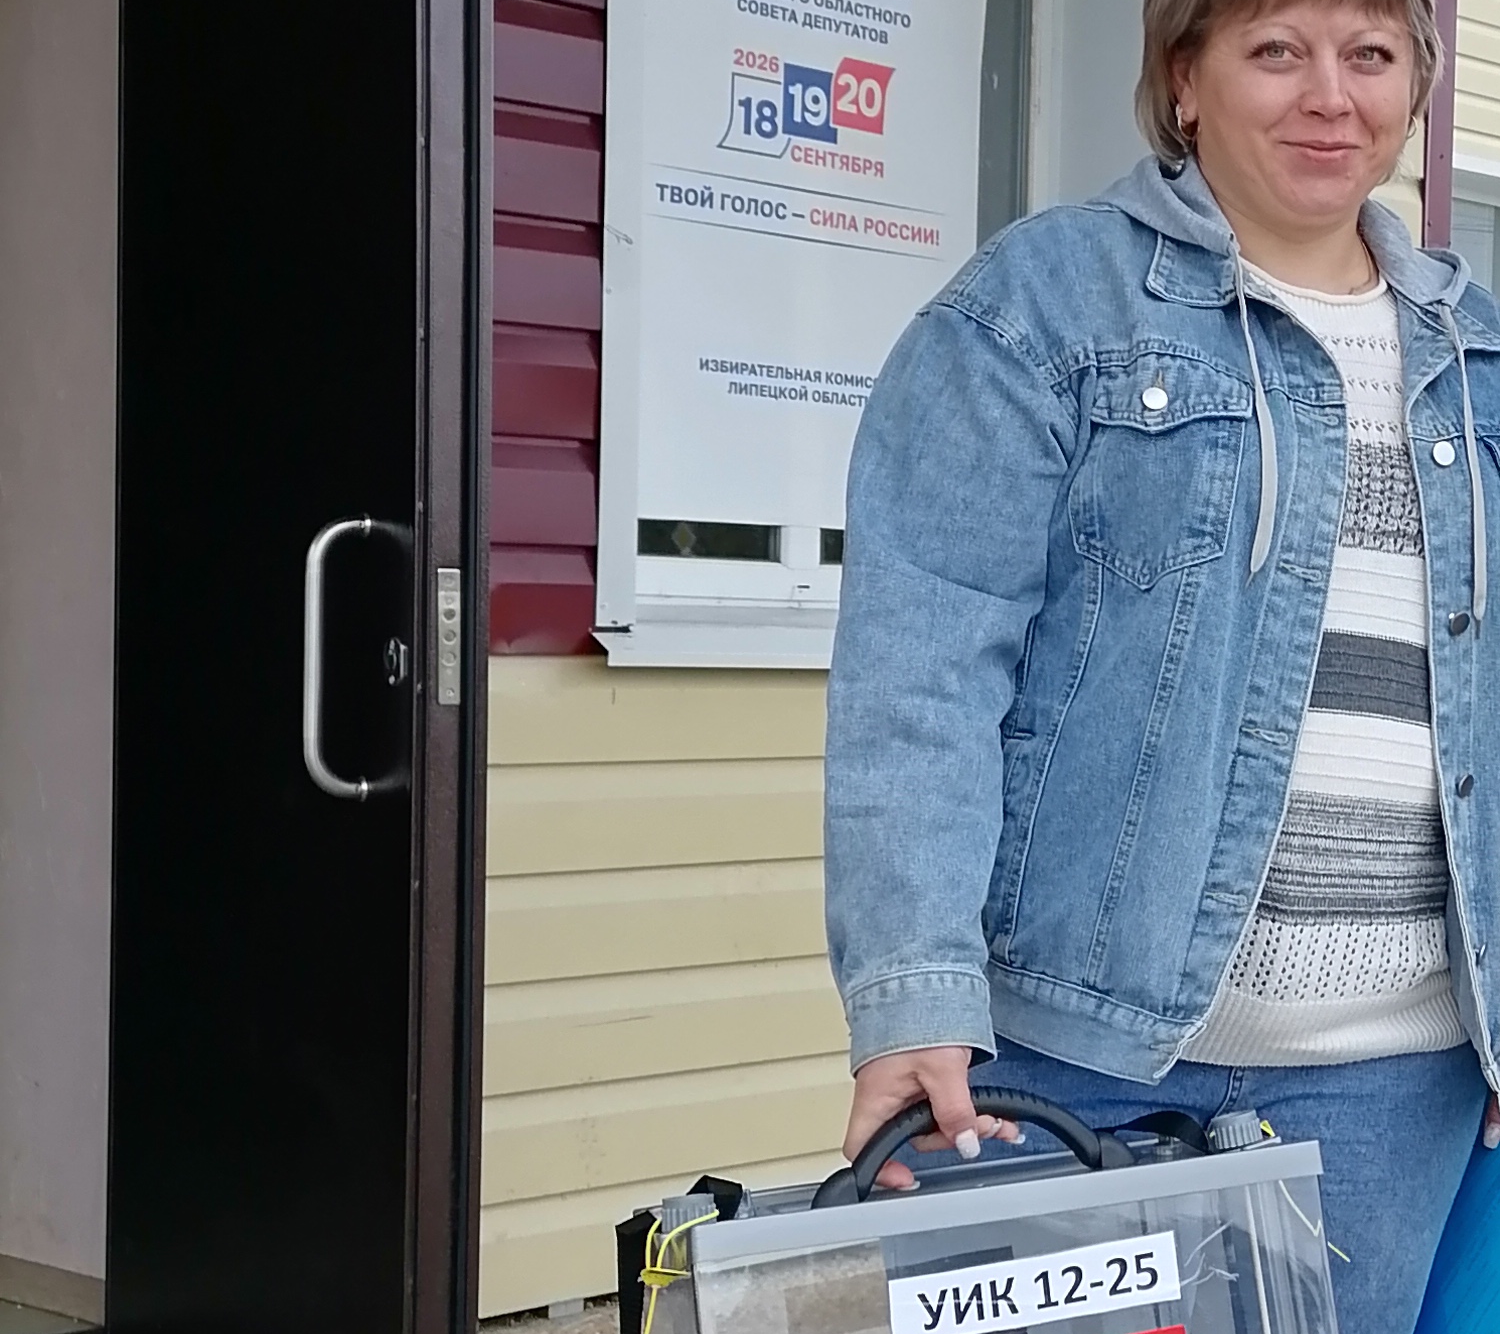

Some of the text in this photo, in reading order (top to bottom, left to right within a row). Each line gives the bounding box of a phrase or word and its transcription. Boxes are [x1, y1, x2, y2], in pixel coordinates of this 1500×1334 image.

[801, 12, 889, 45] ДЕПУТАТОВ
[733, 48, 780, 73] 2026
[737, 73, 882, 139] 18 19 20
[790, 144, 885, 179] СЕНТЯБРЯ
[655, 182, 714, 210] ТВОЙ
[720, 194, 787, 220] ГОЛОС
[809, 208, 859, 233] СИЛА
[863, 218, 940, 247] РОССИИ!
[699, 357, 823, 383] ИЗБИРАТЕЛЬНАЯ
[727, 381, 808, 402] ЛИПЕЦКОЙ
[917, 1251, 1159, 1331] УИК 12-25
